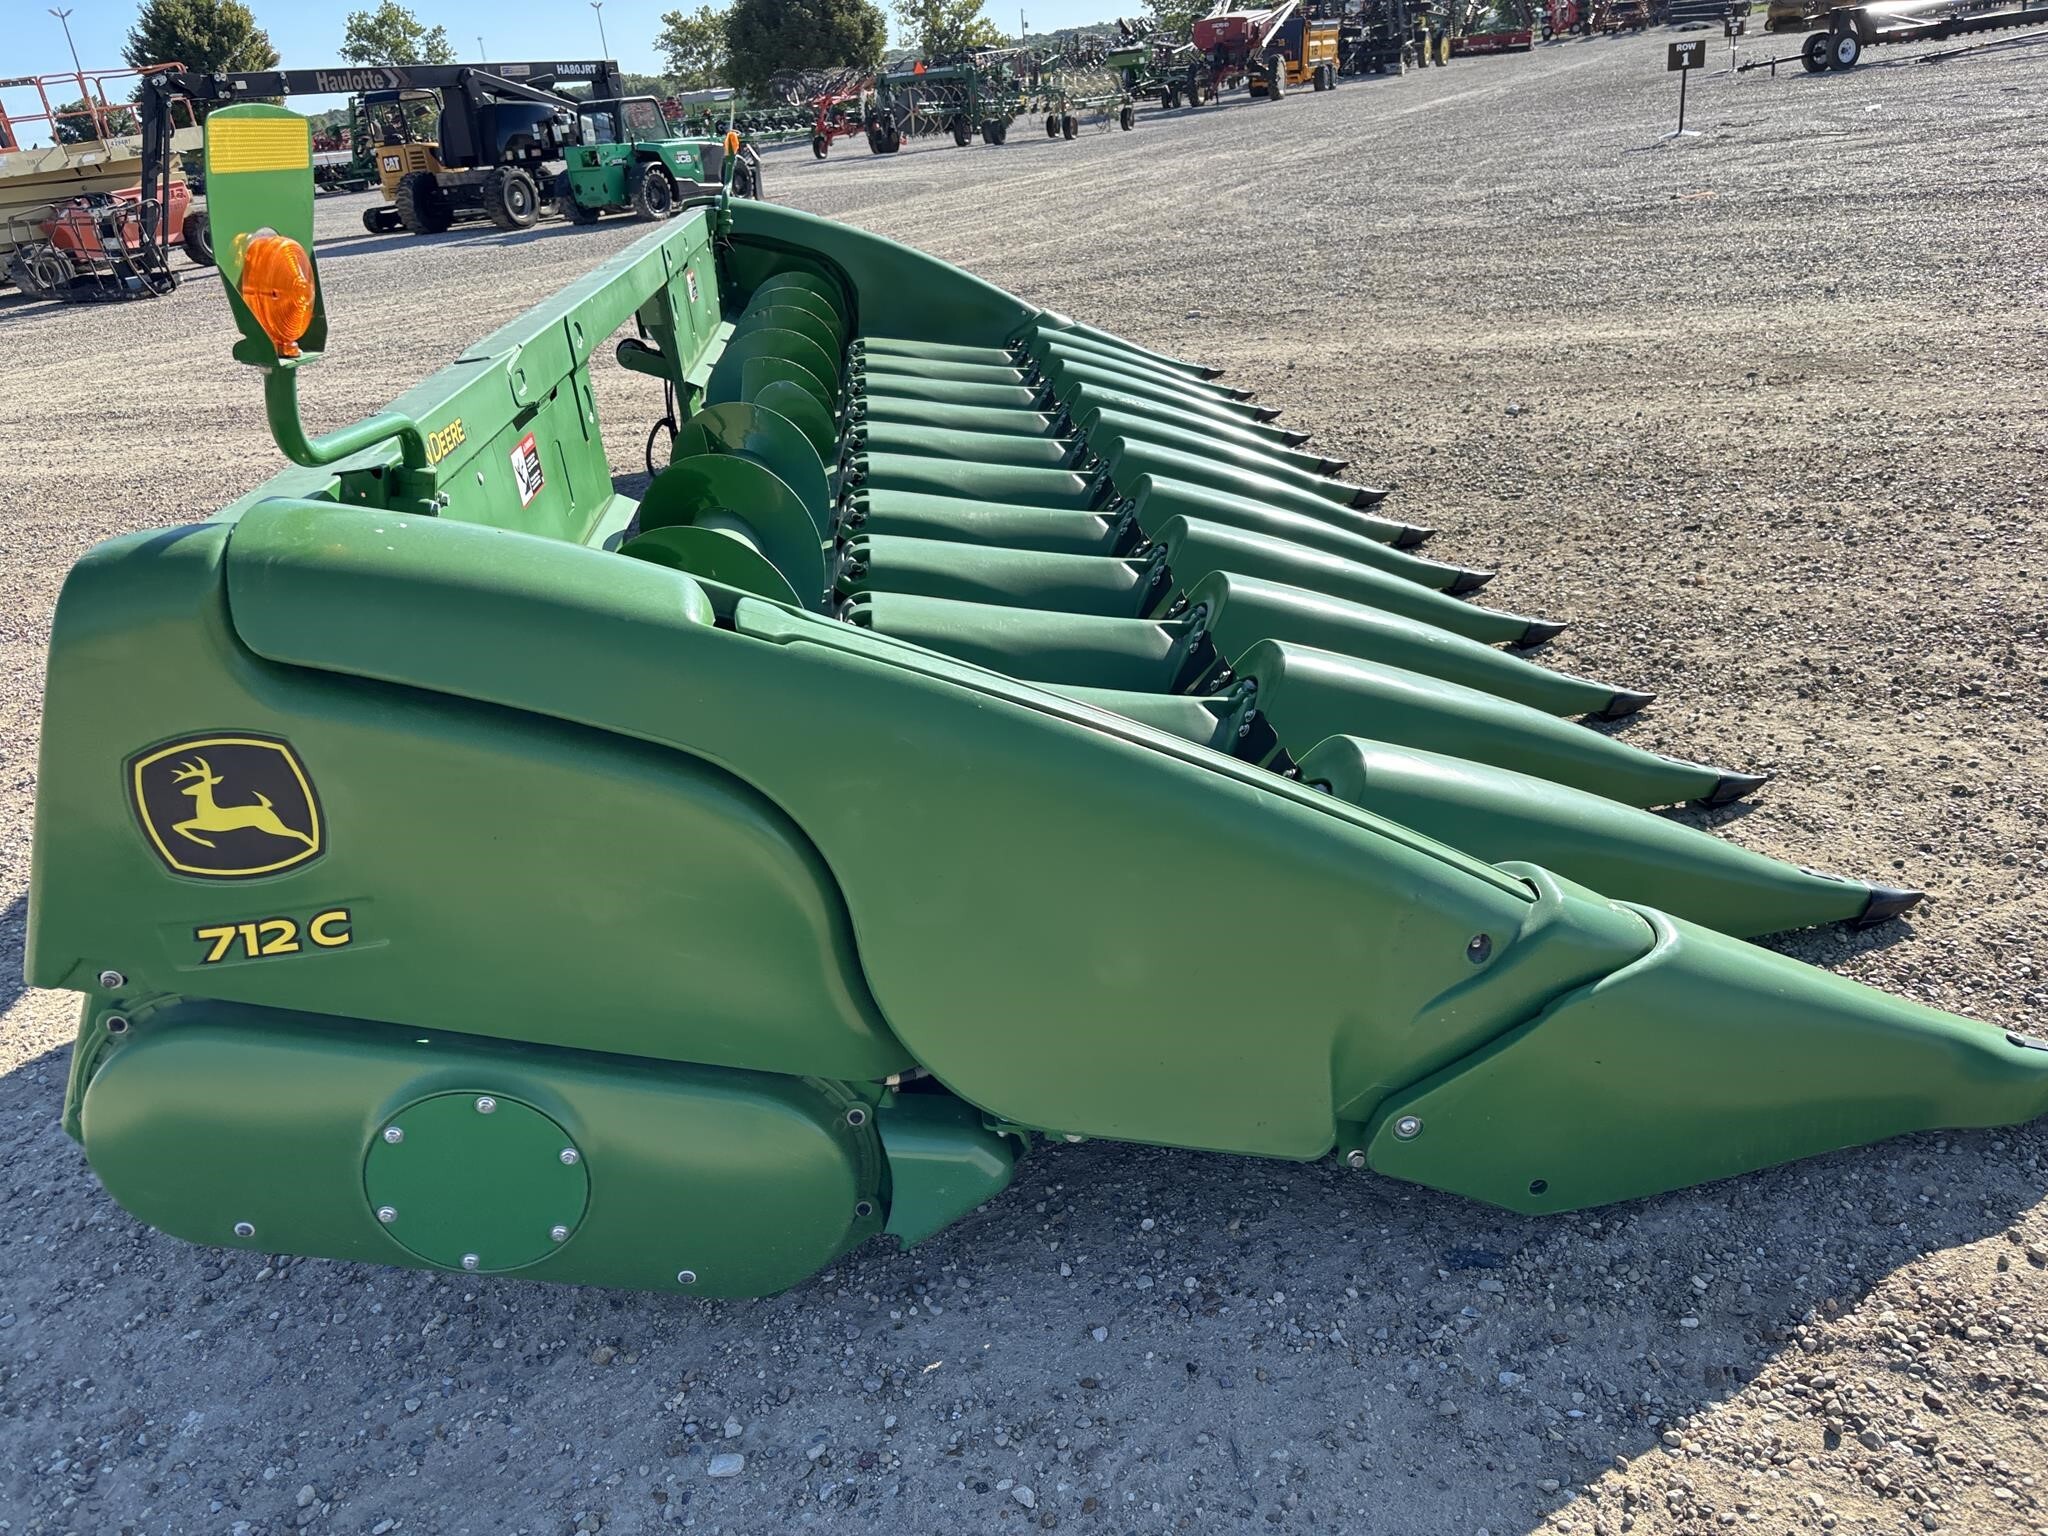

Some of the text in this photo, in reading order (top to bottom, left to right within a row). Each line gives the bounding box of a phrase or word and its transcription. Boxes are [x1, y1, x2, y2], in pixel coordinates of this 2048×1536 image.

[1676, 42, 1697, 52] ROW
[1681, 52, 1690, 66] 1
[556, 64, 597, 75] HA80JRT
[316, 70, 385, 92] Haulotte
[383, 156, 401, 171] CAT
[675, 154, 692, 164] JCB
[428, 417, 466, 464] DEERE
[197, 910, 351, 963] 712 C
